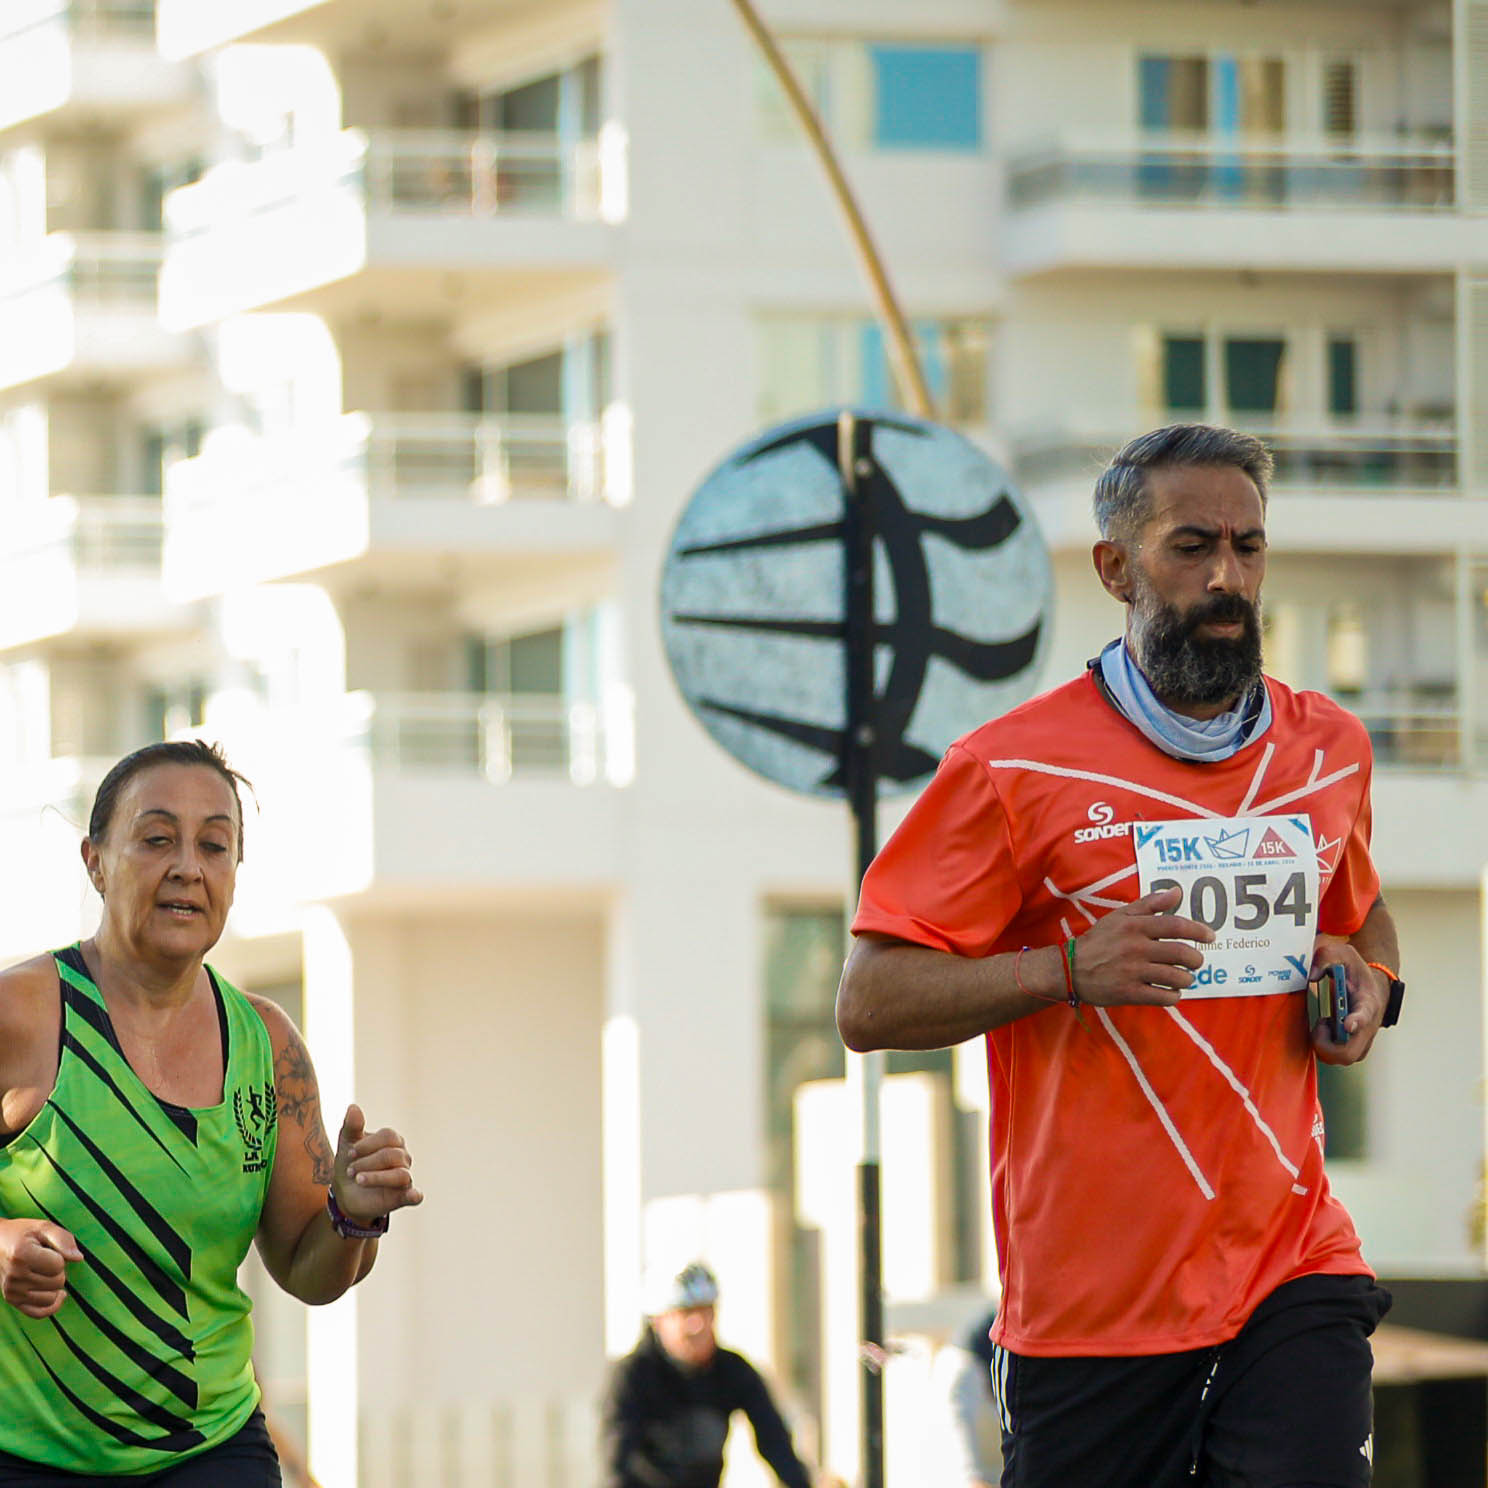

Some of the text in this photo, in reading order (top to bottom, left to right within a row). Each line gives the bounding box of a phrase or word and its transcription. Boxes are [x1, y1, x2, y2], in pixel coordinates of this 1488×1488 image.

[1154, 836, 1203, 863] 15K
[1260, 841, 1286, 854] 15K
[1226, 937, 1271, 950] Federico
